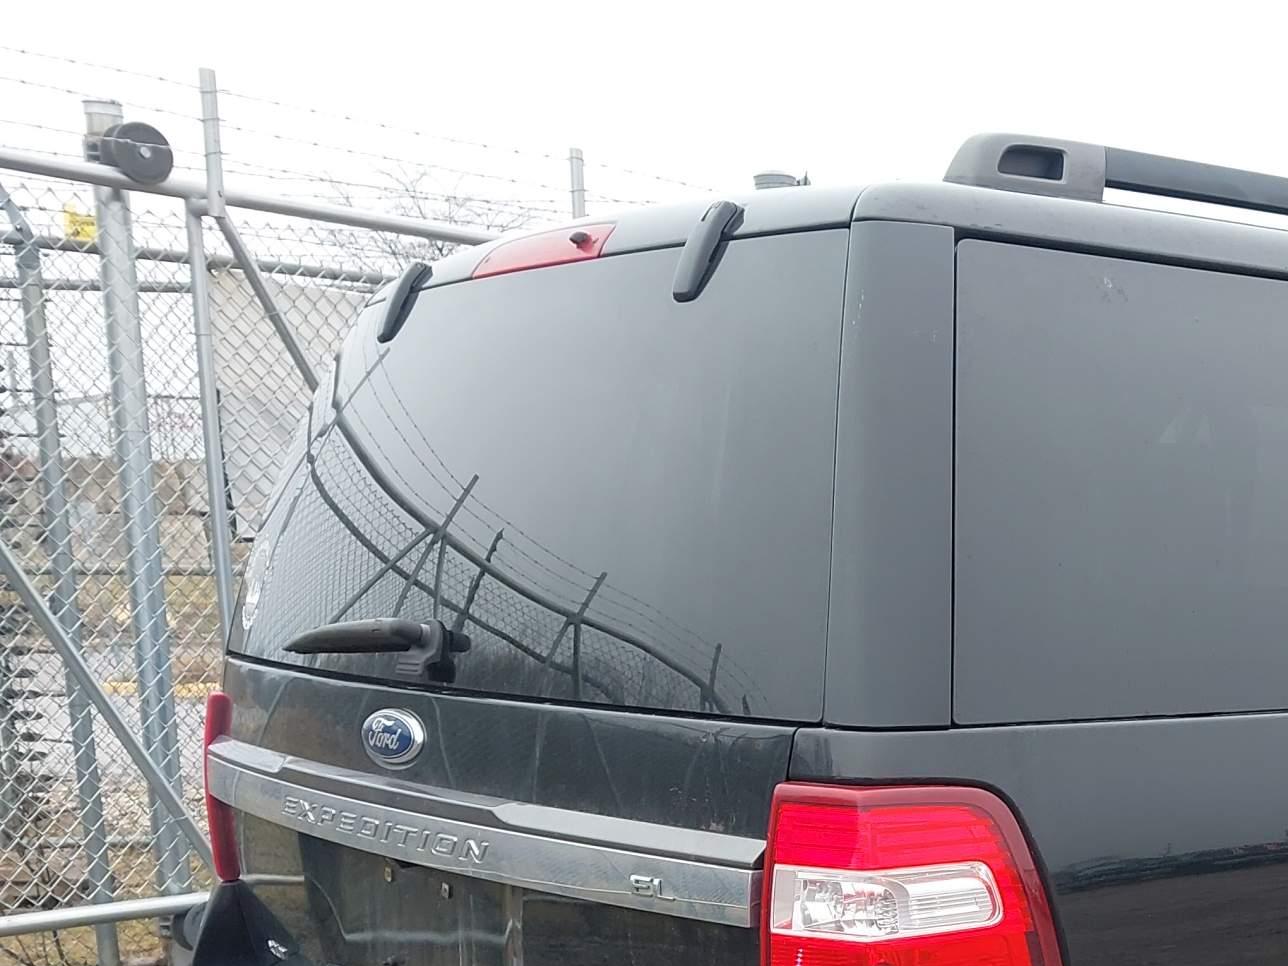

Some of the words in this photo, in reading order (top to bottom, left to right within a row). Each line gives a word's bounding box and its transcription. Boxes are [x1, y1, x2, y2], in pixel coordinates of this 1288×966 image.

[367, 717, 402, 750] Ford
[280, 795, 491, 865] EXPEDITION
[629, 873, 676, 902] EL
